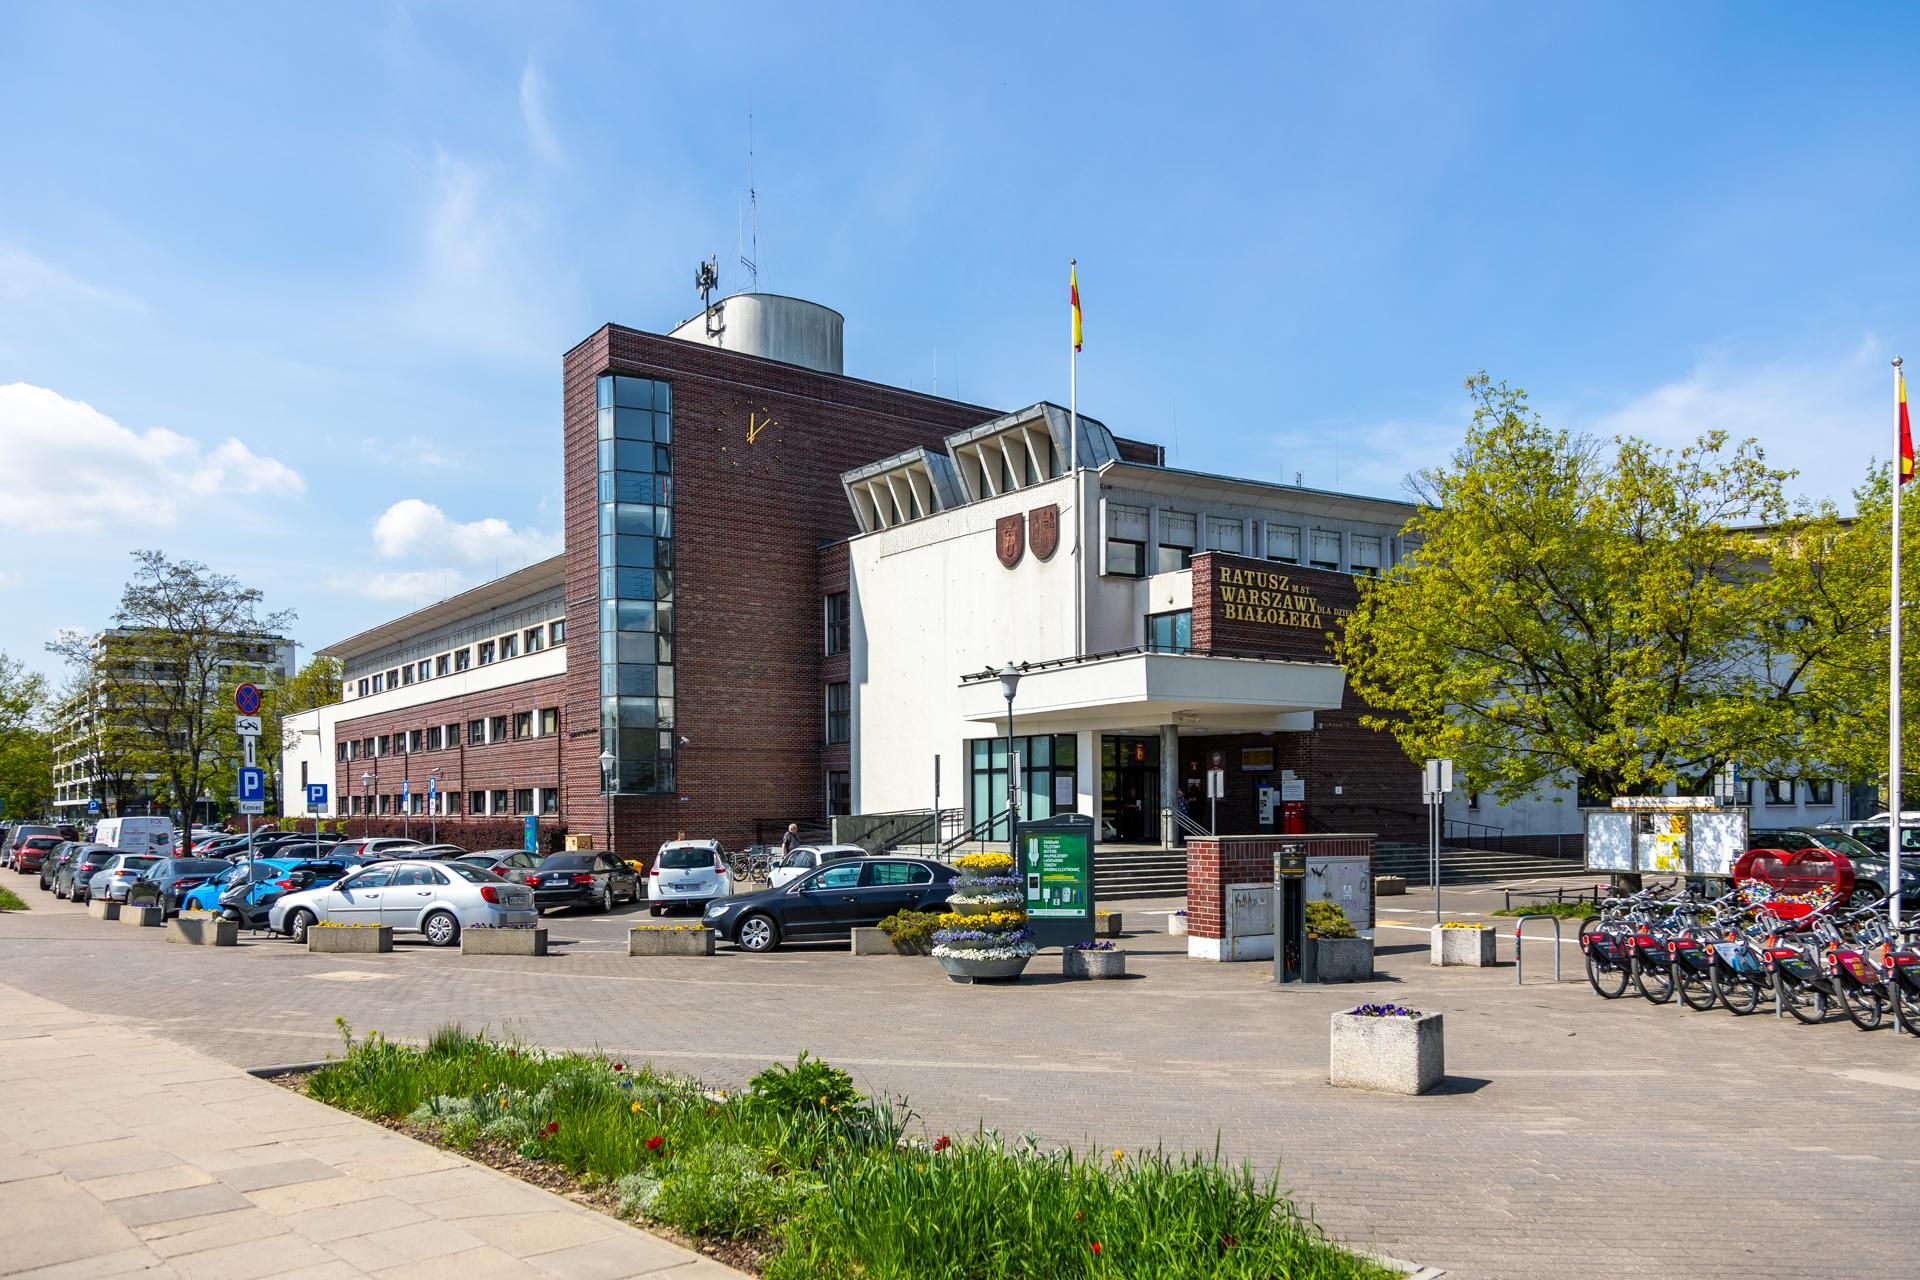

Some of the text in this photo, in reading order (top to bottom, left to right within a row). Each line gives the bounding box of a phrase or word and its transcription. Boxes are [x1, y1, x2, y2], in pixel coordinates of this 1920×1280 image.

[1219, 566, 1289, 591] RATUSZ
[1219, 586, 1317, 613] WARSZAWY
[1317, 606, 1331, 615] DLA
[244, 771, 259, 797] P
[311, 786, 324, 801] P
[242, 802, 263, 811] Koniec
